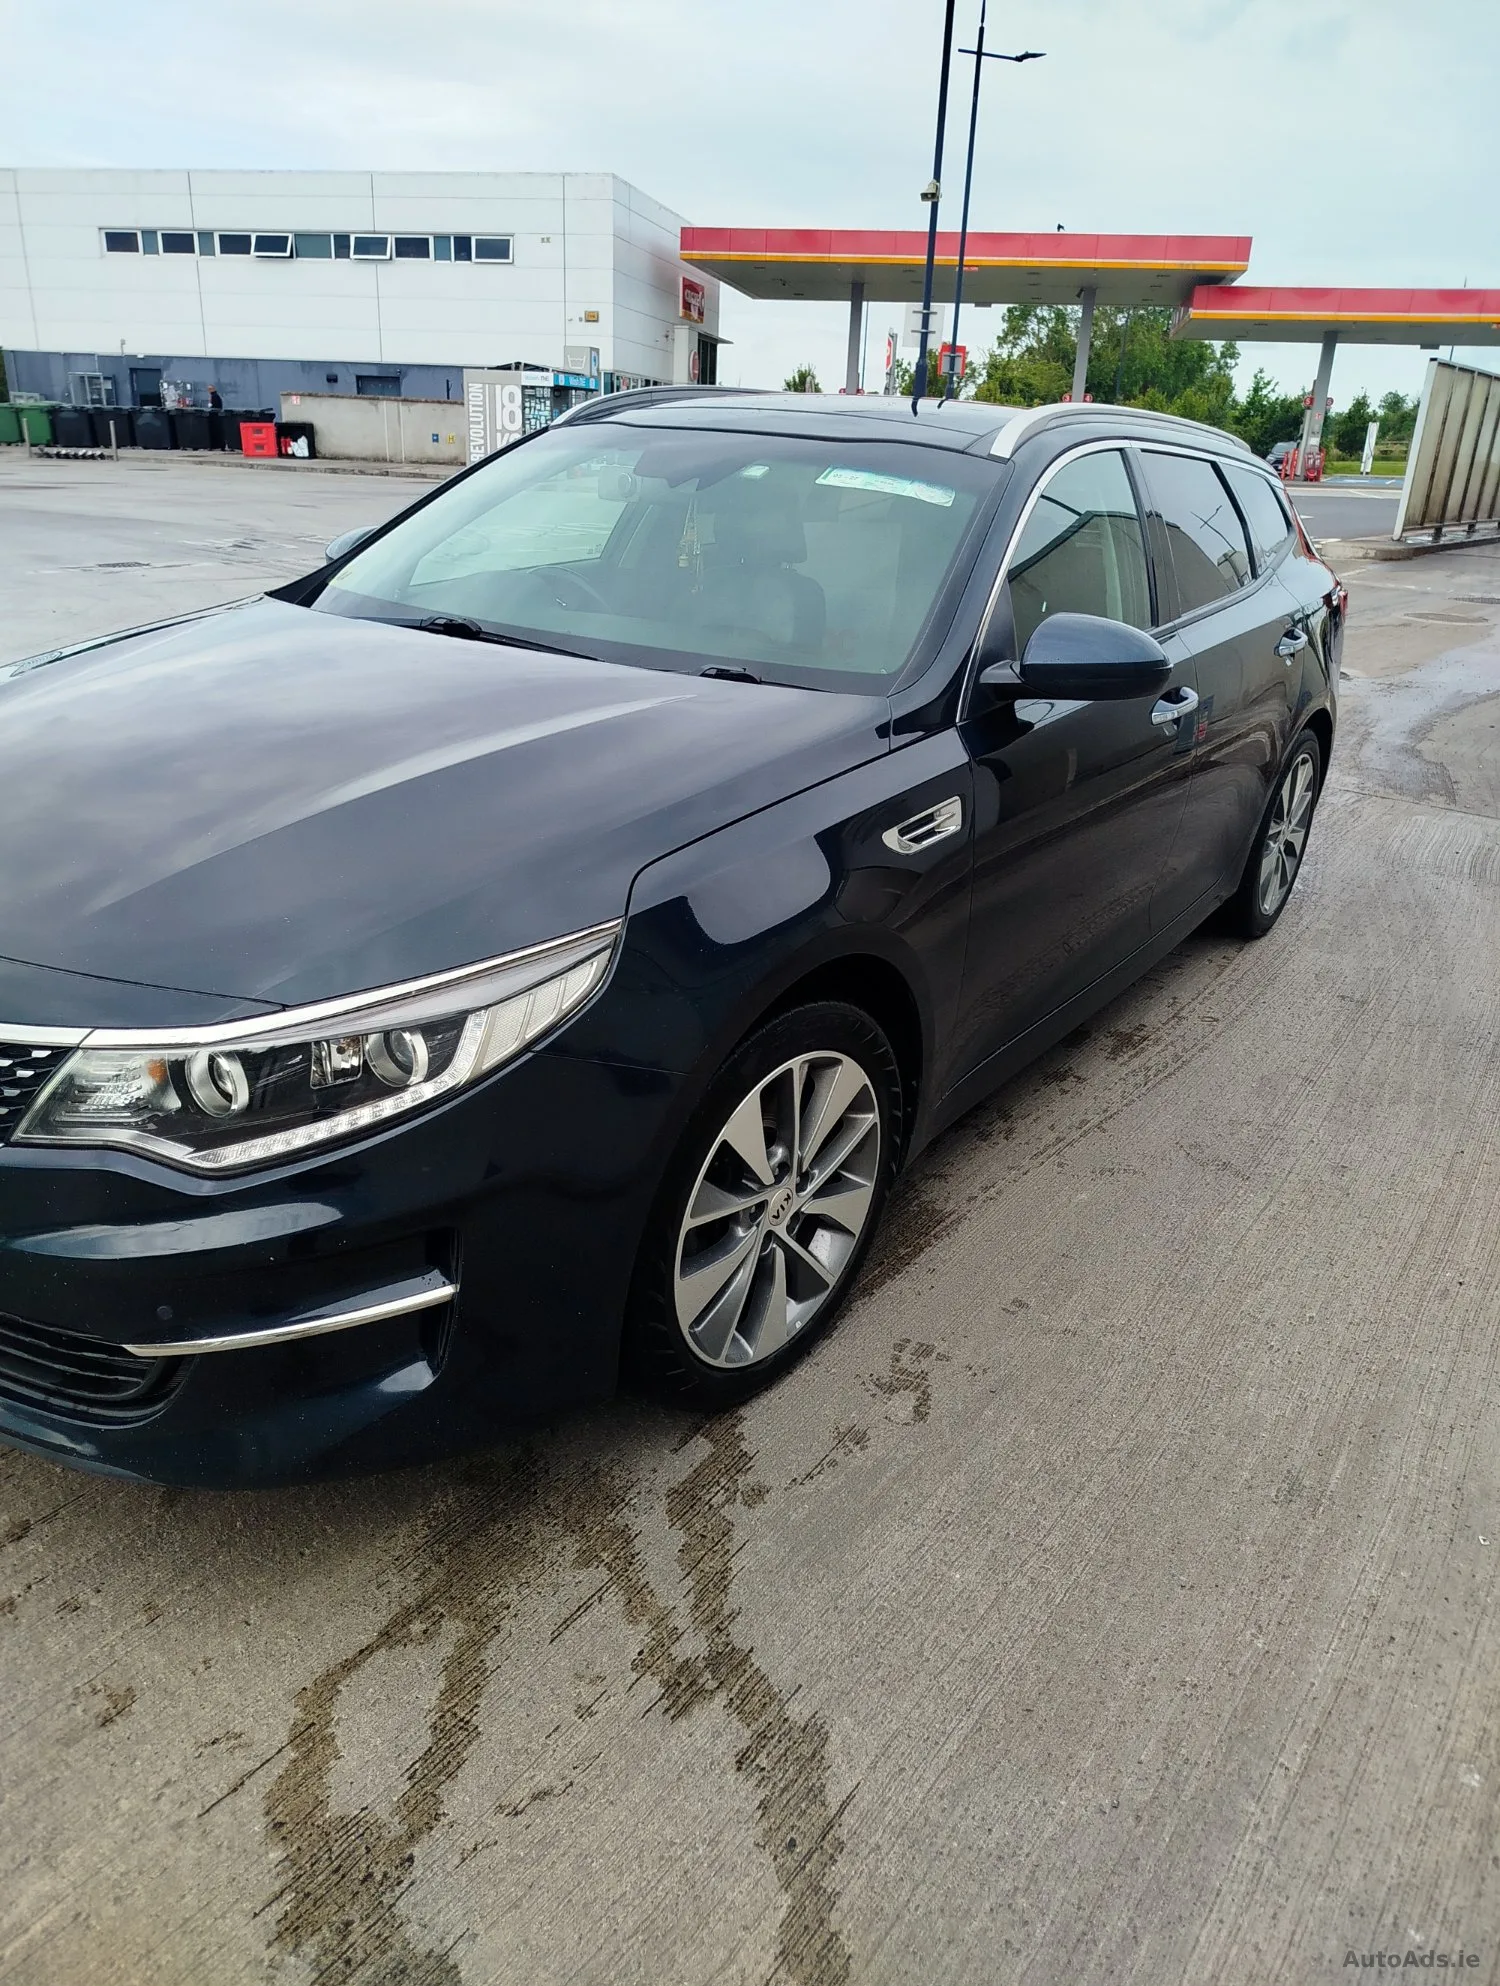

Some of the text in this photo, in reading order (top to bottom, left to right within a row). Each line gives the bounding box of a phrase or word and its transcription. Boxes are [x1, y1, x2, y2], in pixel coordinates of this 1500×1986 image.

[468, 384, 485, 462] REVOLUTION
[495, 384, 522, 431] 18
[772, 1192, 792, 1219] KIA
